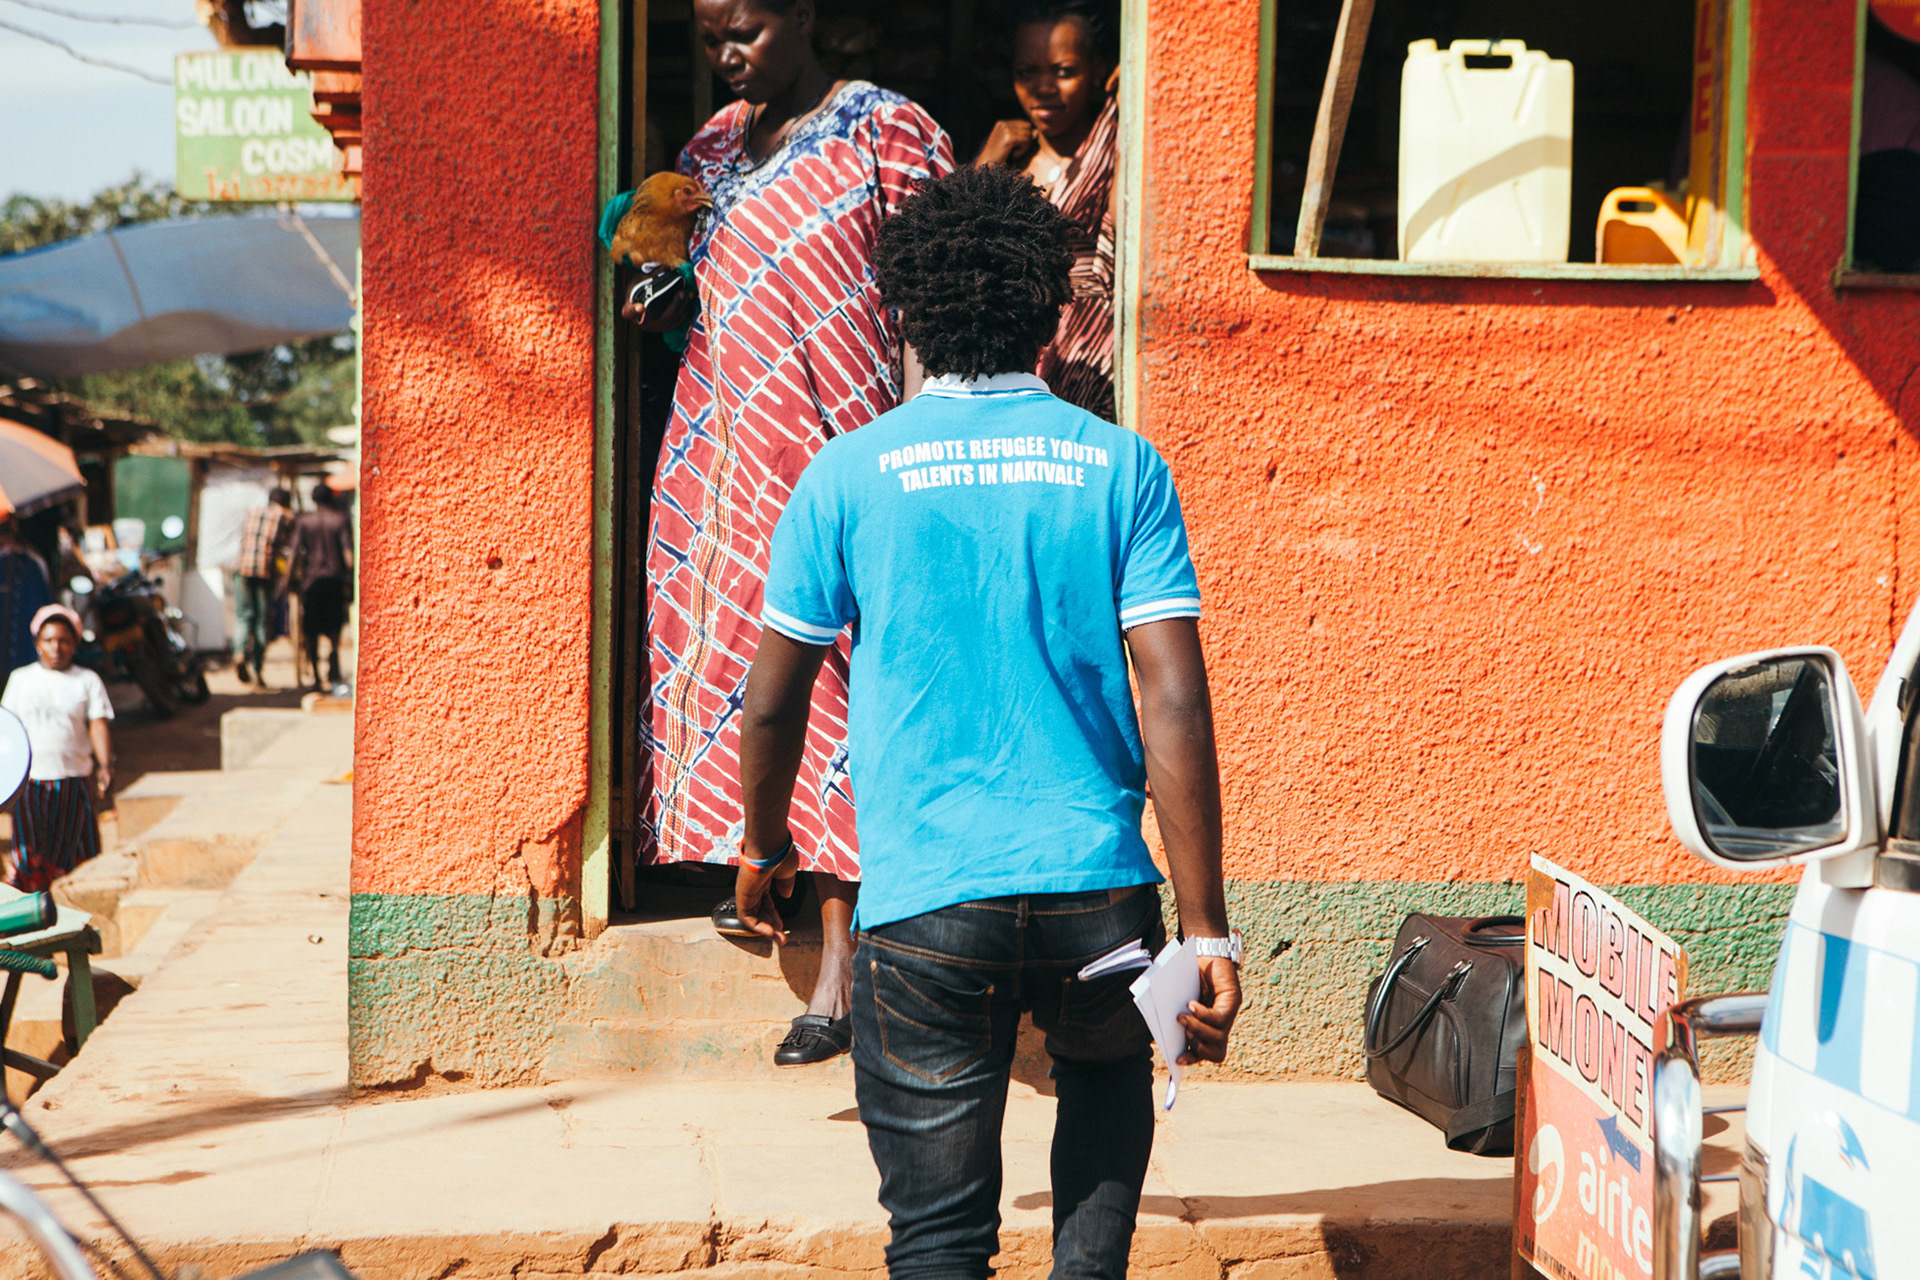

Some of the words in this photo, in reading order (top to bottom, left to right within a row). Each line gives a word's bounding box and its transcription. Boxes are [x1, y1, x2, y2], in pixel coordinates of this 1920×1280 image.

[177, 96, 293, 137] SALOON
[878, 440, 966, 473] PROMOTE
[969, 436, 1046, 460] REFUGEE
[1050, 437, 1109, 467] YOUTH
[898, 464, 975, 493] TALENTS
[978, 463, 998, 485] IN
[1002, 460, 1085, 487] NAKIVALE
[1533, 878, 1677, 1028] MOBILE
